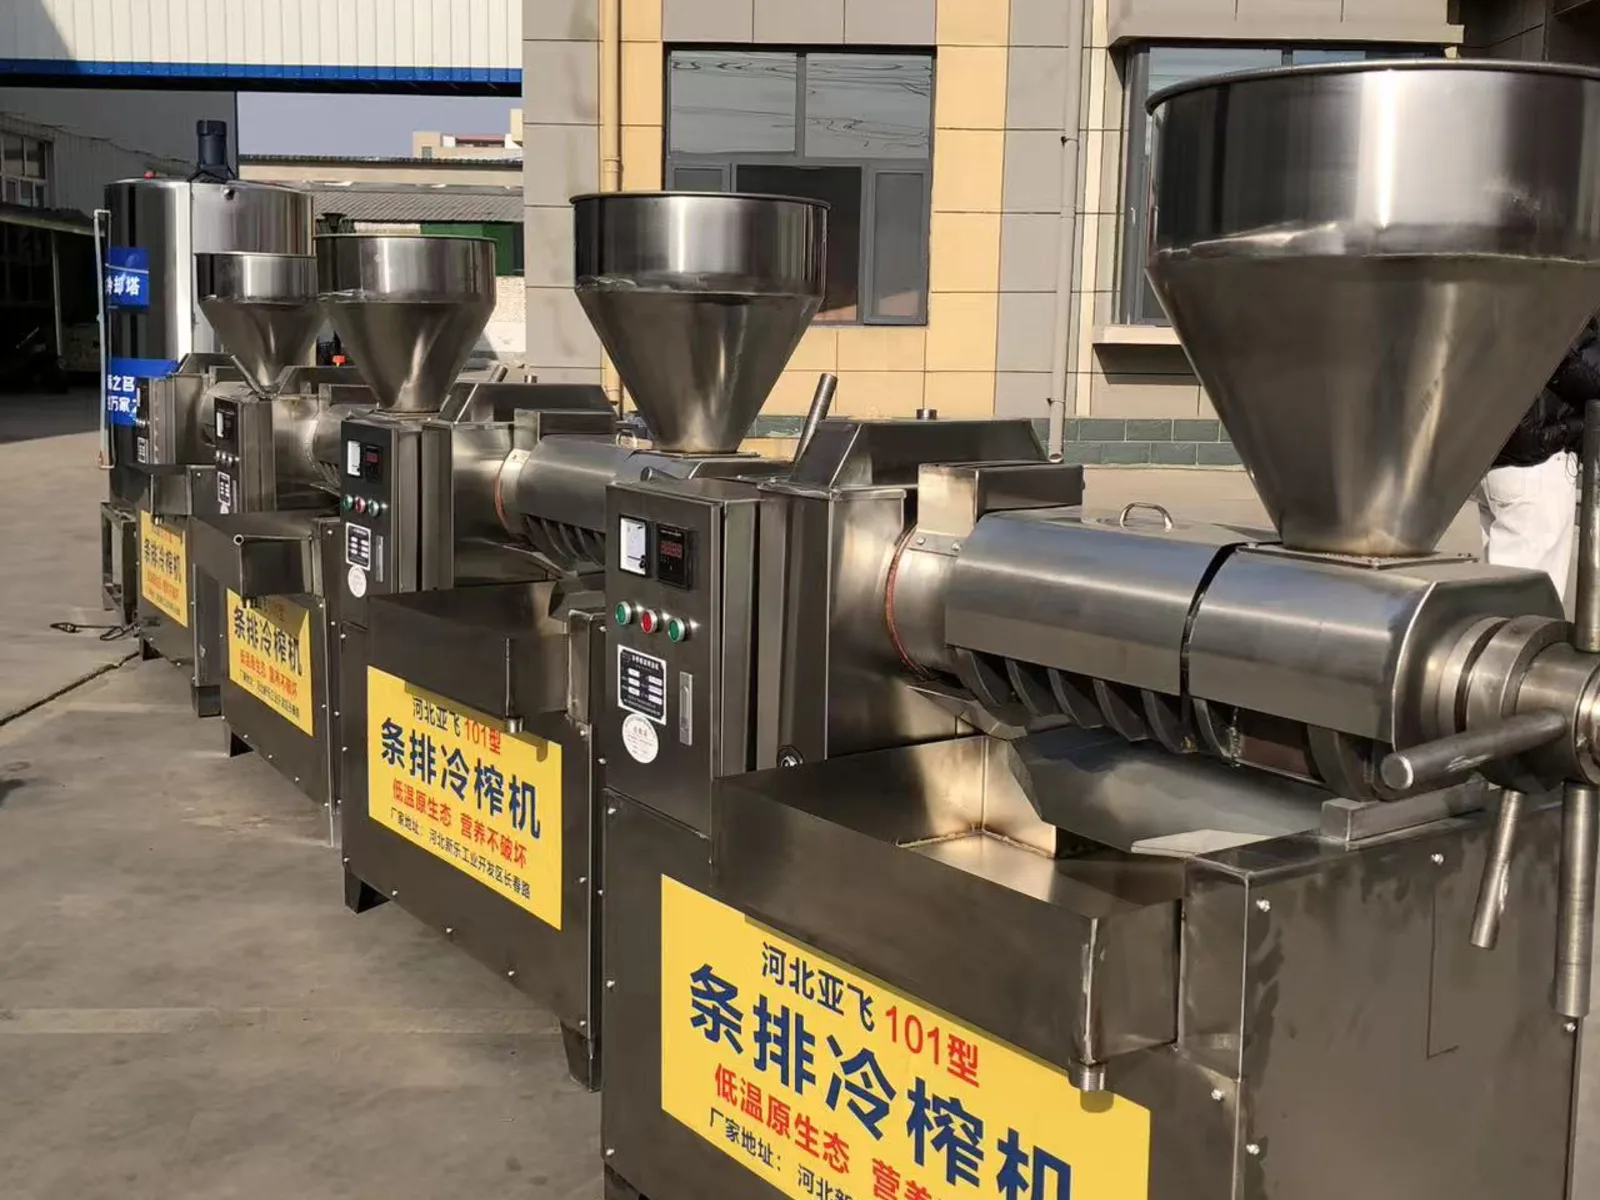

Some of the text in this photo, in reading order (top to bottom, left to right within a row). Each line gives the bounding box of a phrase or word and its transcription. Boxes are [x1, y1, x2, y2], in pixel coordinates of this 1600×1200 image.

[381, 717, 540, 839] 条排冷榨机
[412, 696, 501, 755] 河北亚飞 101型
[393, 777, 527, 869] 低温原生态 营养不破坏
[761, 941, 980, 1089] 河北亚飞 101型
[689, 963, 1072, 1200] 条排冷榨机
[715, 1063, 850, 1174] 低温原生态
[709, 1107, 783, 1172] 厂家地址：
